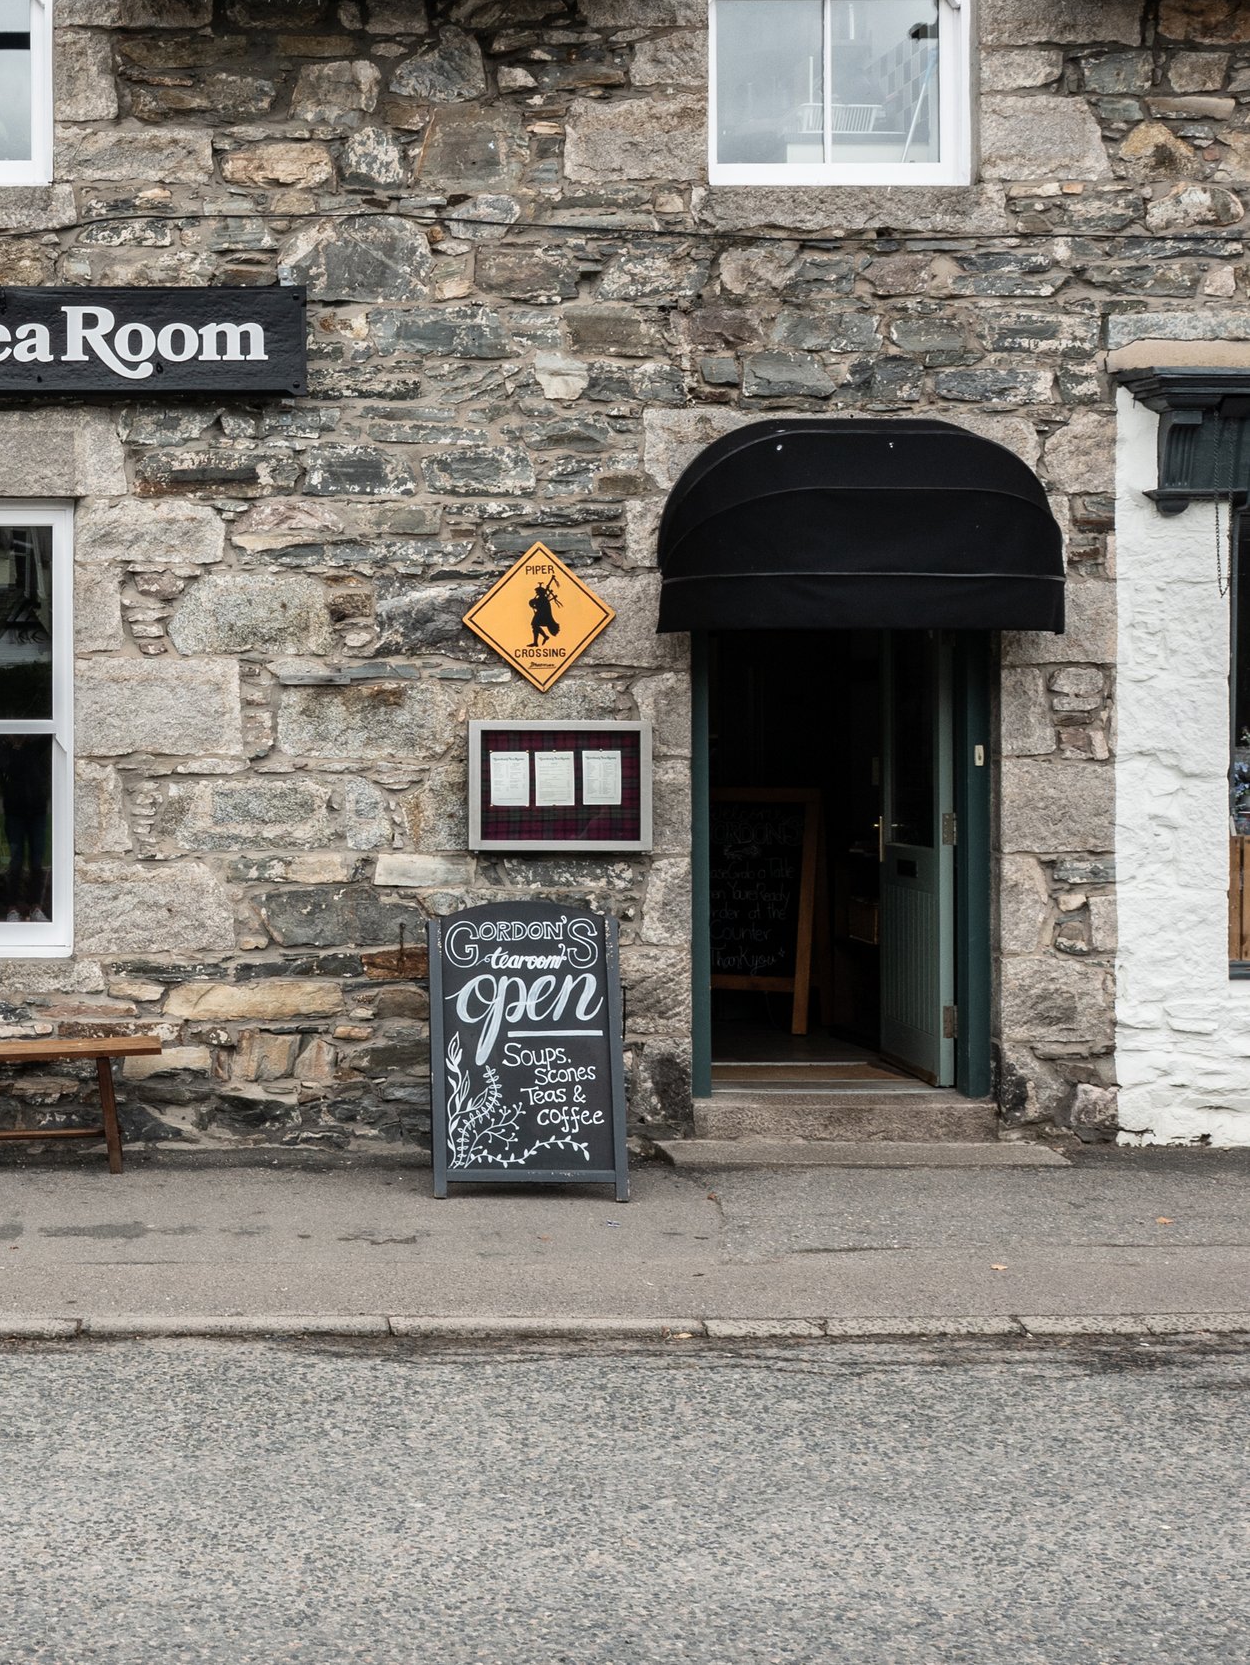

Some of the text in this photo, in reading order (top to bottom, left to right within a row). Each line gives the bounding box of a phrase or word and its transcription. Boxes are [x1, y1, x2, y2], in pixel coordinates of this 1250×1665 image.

[60, 305, 270, 379] Room
[525, 565, 555, 575] PIPER
[514, 648, 566, 658] CROSSING
[711, 901, 787, 920] rder at the
[444, 915, 598, 969] GORDON'S
[710, 919, 772, 942] Counter
[475, 943, 568, 970] tearoom
[445, 973, 603, 1066] open
[520, 1085, 587, 1105] Teas &
